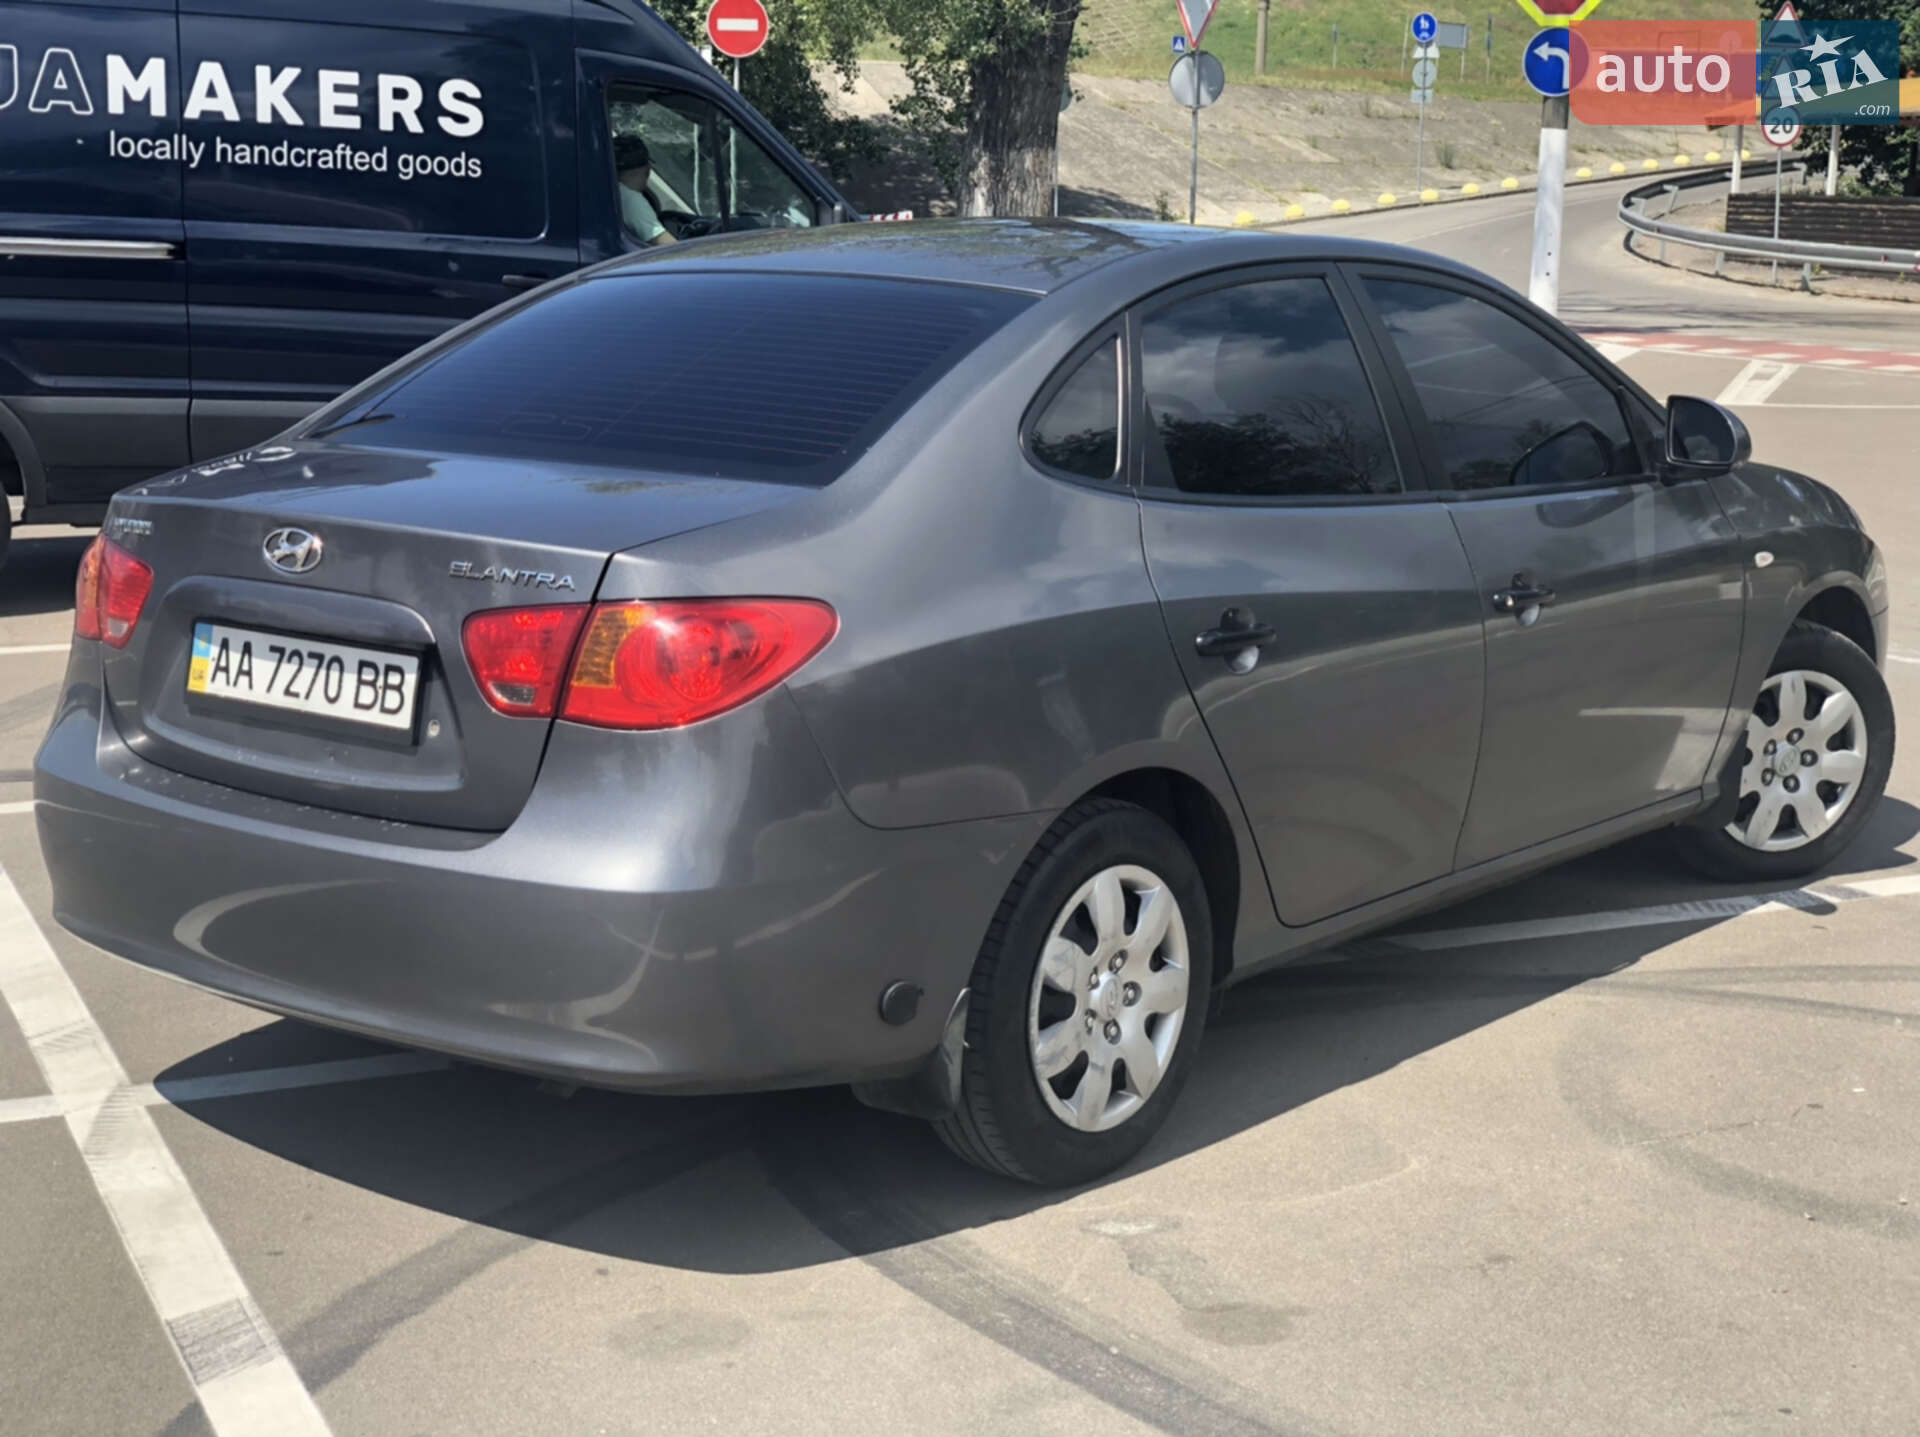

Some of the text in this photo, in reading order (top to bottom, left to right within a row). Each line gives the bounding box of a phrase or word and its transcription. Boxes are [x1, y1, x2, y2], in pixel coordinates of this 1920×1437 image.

[1770, 117, 1794, 135] 20
[109, 130, 482, 180] locally handcrafted goods
[449, 560, 575, 592] ELANTRA
[210, 636, 406, 716] AA 7270 BB
